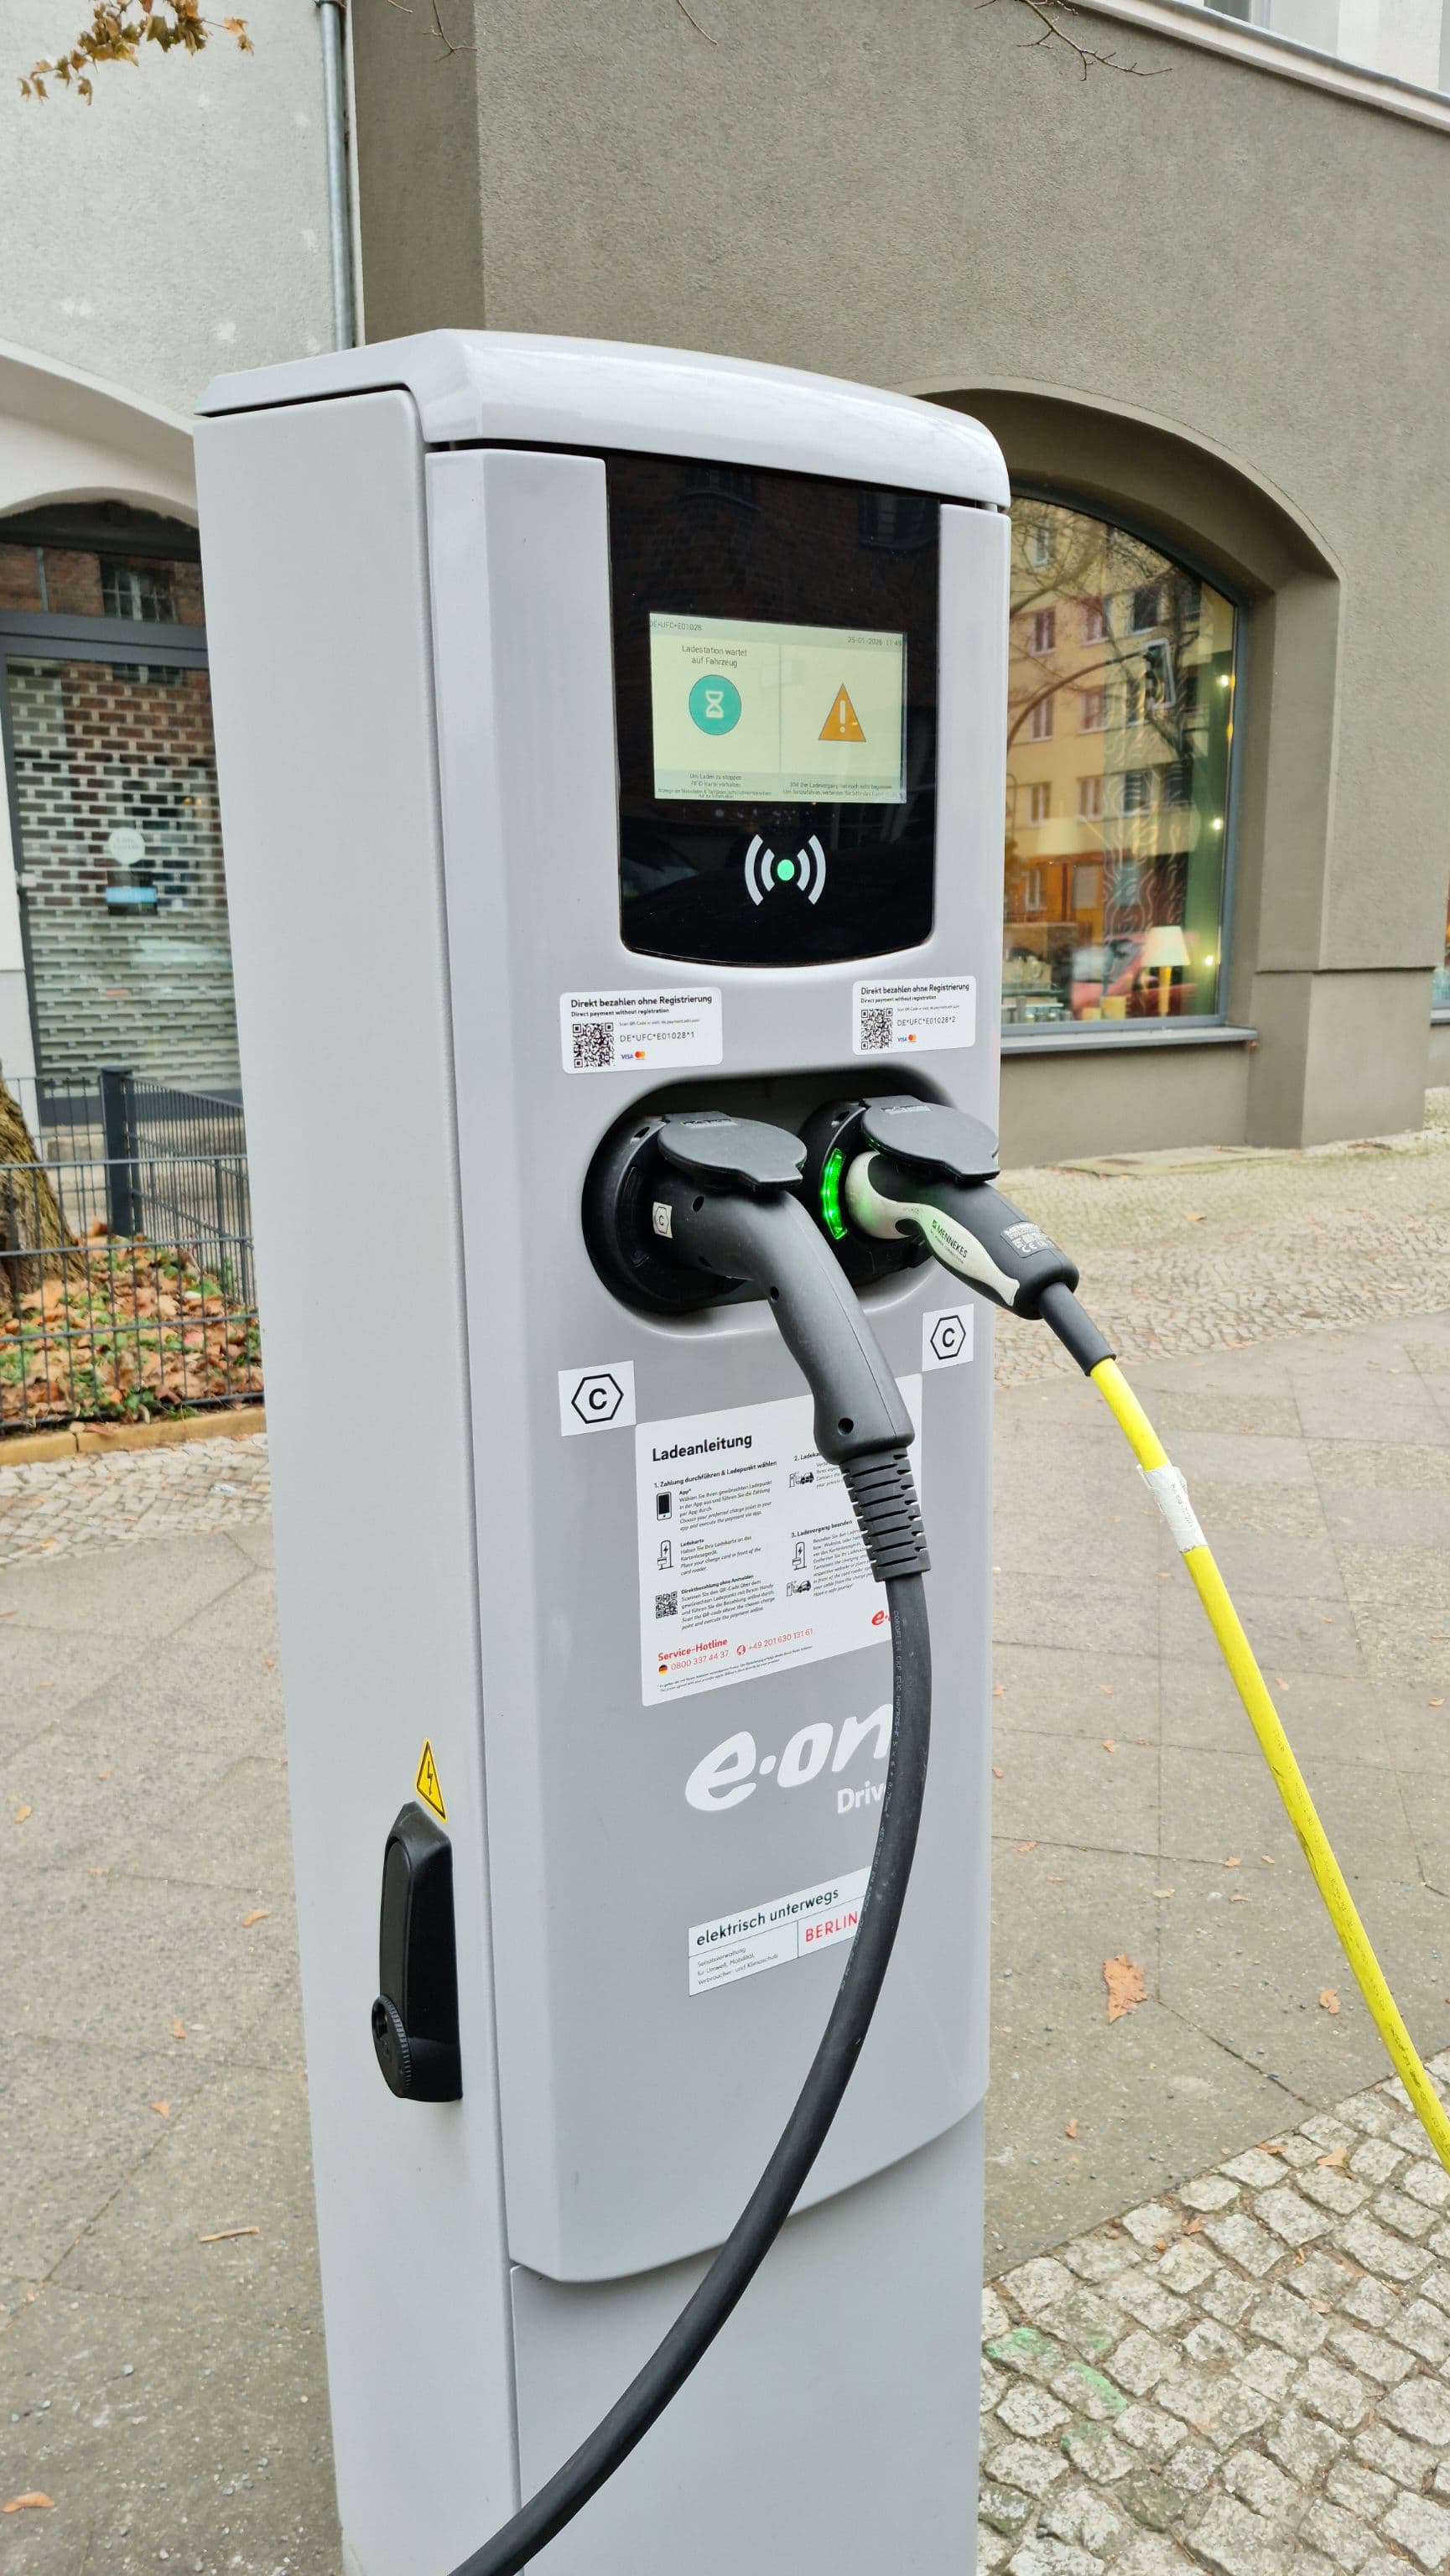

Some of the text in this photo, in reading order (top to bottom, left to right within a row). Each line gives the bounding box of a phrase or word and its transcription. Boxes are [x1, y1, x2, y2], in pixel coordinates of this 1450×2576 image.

[682, 645, 747, 657] Ladestation wartet
[705, 657, 738, 668] Fahrzeug
[928, 984, 969, 993] Registrierung
[599, 998, 636, 1006] bezahlen
[659, 995, 712, 1005] Registrierung
[658, 1214, 665, 1228] C
[935, 1223, 969, 1259] MENNEKES
[942, 1327, 956, 1348] C
[589, 1388, 607, 1410] C
[652, 1435, 752, 1462] Ladeanleitung
[800, 1451, 819, 1460] Ladeka
[684, 1472, 720, 1483] durchführen
[726, 1465, 756, 1474] Ladepunkt
[749, 1480, 772, 1488] Ladepunkt
[797, 1525, 830, 1536] Ladevorgang
[831, 1520, 852, 1529] beenden
[681, 1583, 719, 1594] Direktbezahlung
[713, 1592, 736, 1602] Ladepunkt
[748, 1642, 761, 1650] +49
[764, 1638, 777, 1647] 201
[777, 1634, 792, 1643] 630
[793, 1631, 803, 1639] 131
[657, 1639, 728, 1661] Service-Hotline
[671, 1659, 691, 1670] 0800
[694, 1655, 706, 1665] 337
[837, 1780, 886, 1814] Driv
[697, 1888, 839, 1946] elektrisch unterwegs
[805, 1911, 858, 1943] BERLIN
[698, 1948, 746, 1967] Senatsverwaltung
[706, 1962, 728, 1973] Umwelt,
[730, 1952, 755, 1965] Mobilität,
[735, 1964, 746, 1972] und
[746, 1954, 778, 1967] Klimaschutz
